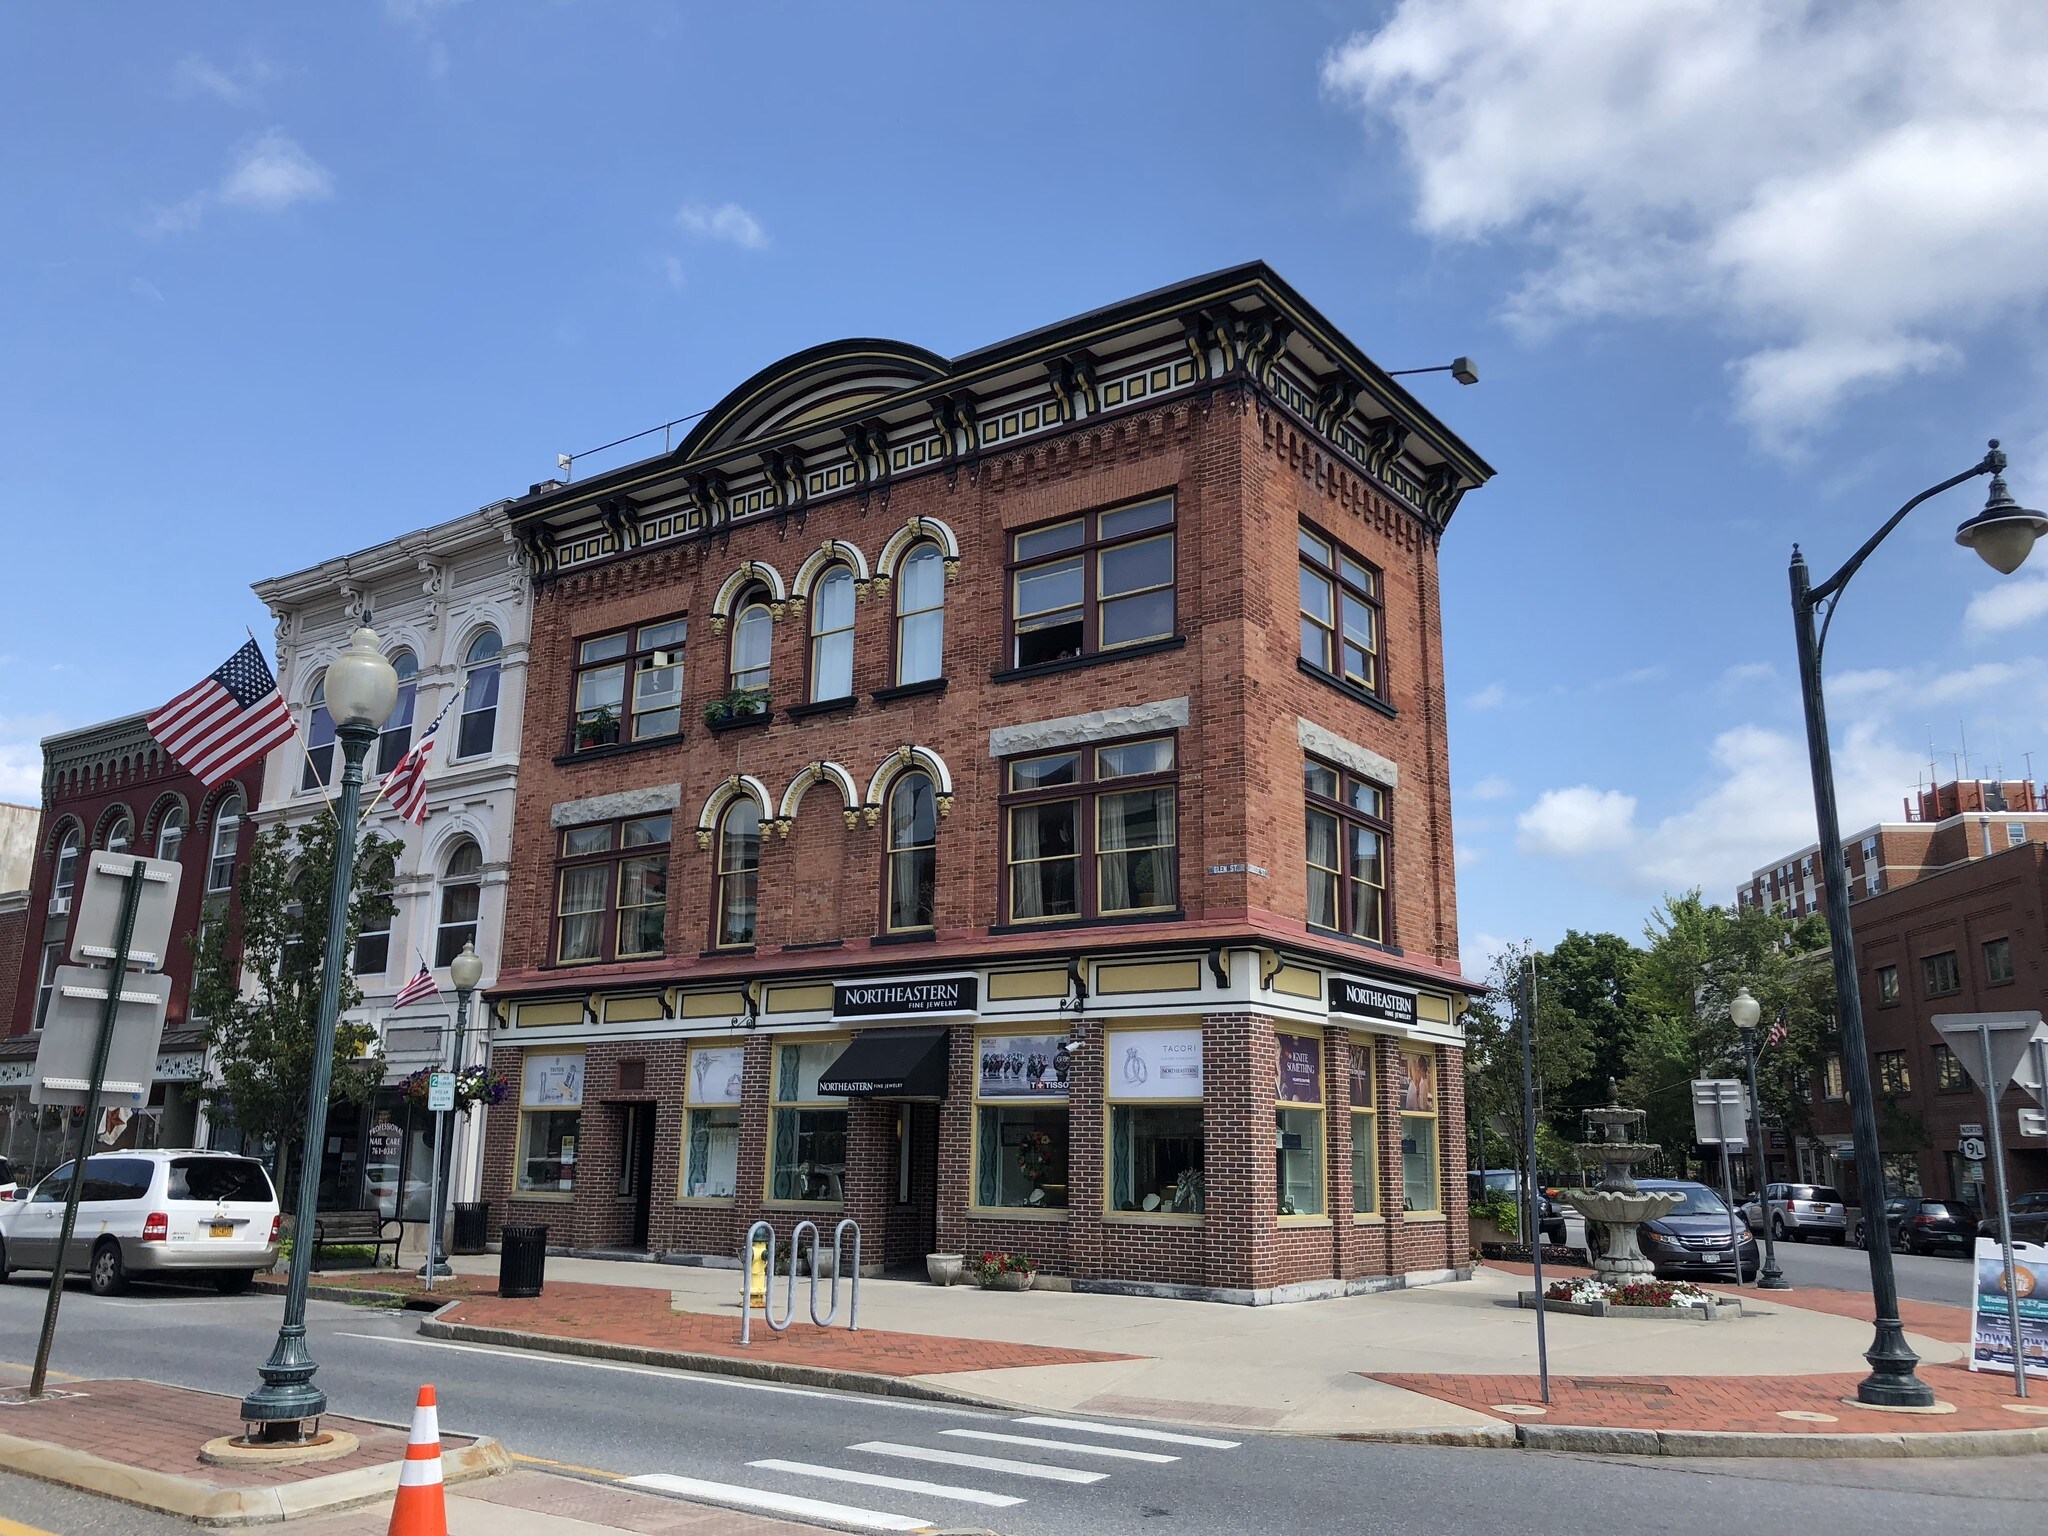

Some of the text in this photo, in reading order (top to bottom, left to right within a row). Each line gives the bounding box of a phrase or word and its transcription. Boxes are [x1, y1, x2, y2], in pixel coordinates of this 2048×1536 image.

[1213, 866, 1228, 874] GLEN
[845, 984, 959, 1005] NORTHEASTERN
[1346, 984, 1412, 1013] NORTHEASTERN
[926, 1000, 958, 1009] JEWELRY
[1394, 1012, 1412, 1020] JEWELRY
[1162, 1044, 1196, 1052] TACORI
[1292, 1051, 1309, 1063] IGNITE
[1286, 1061, 1315, 1075] SOMETHING
[431, 1075, 438, 1086] 2
[1045, 1081, 1070, 1089] TISSO
[819, 1082, 873, 1091] NORTHEASTERN
[369, 1122, 404, 1137] PROFESSIONAL
[1961, 1126, 1981, 1134] NORTH
[370, 1137, 401, 1146] NAIL CARE
[372, 1147, 397, 1155] 761-0345
[1966, 1142, 1984, 1155] 9L
